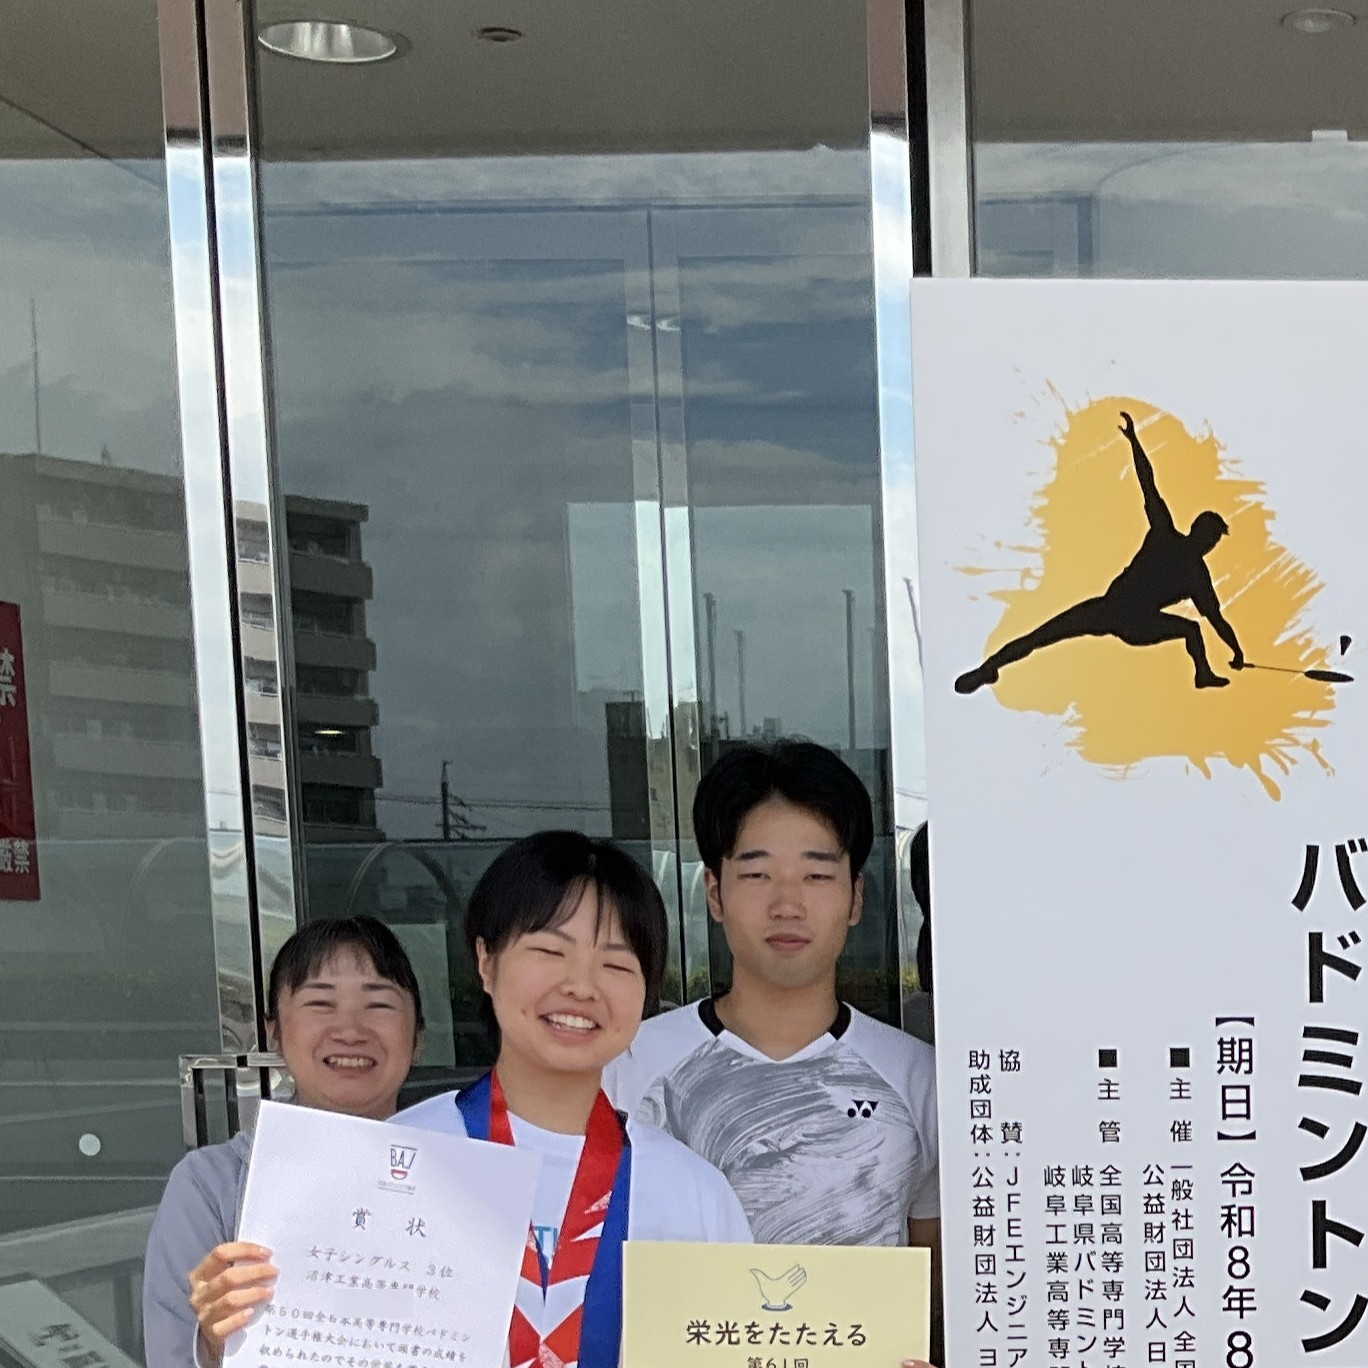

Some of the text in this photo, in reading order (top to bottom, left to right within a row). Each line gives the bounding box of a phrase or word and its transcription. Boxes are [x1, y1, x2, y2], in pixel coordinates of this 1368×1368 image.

[686, 1320, 867, 1346] 栄光をたたえる
